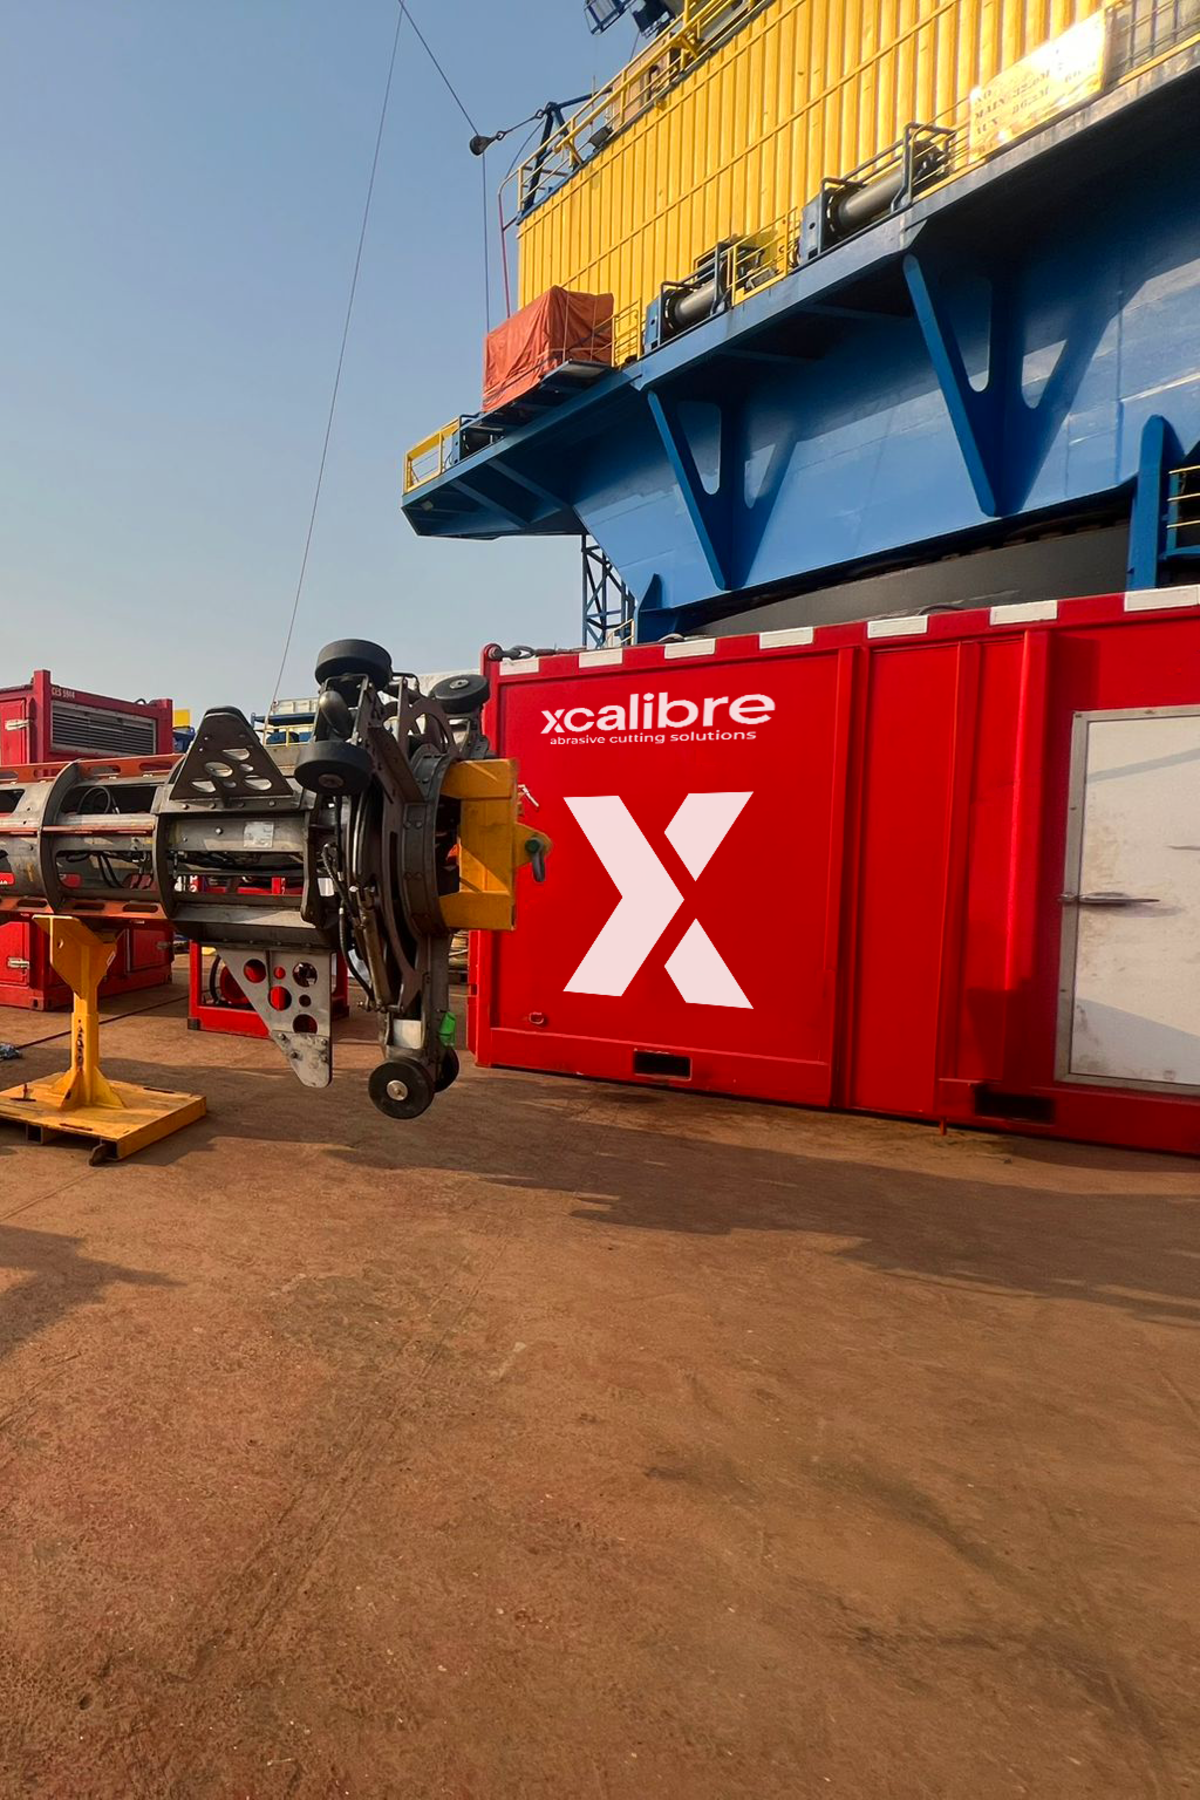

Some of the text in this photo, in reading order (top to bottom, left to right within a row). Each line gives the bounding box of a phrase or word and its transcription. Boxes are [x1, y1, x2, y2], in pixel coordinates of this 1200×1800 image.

[540, 692, 776, 735] xcalibre
[550, 729, 758, 745] abrasive cutting solutions
